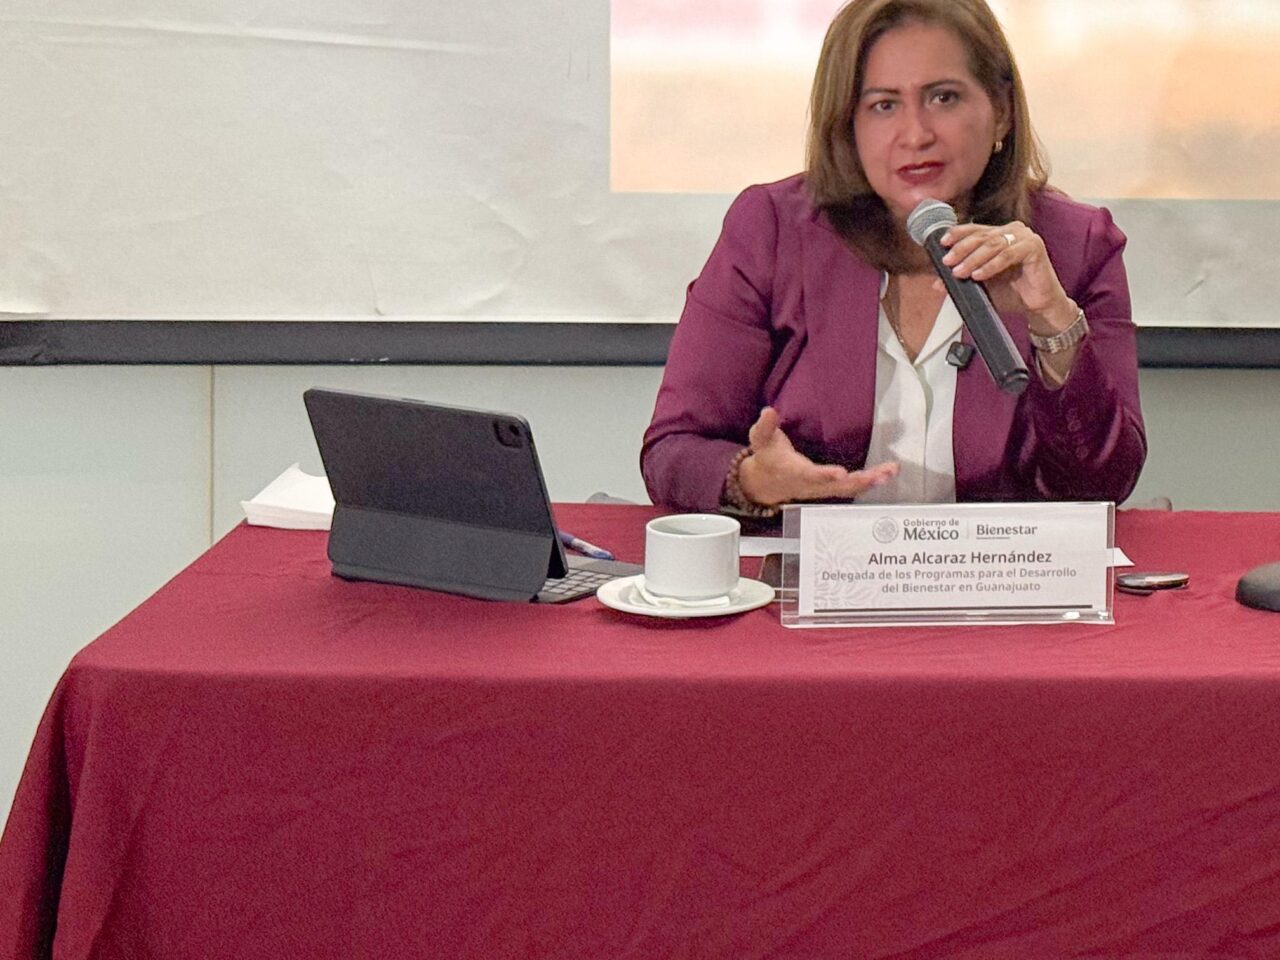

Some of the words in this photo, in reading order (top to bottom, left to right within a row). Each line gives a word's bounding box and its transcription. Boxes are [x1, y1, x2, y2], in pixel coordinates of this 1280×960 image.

[903, 518, 946, 527] Gobierno
[949, 518, 960, 527] de
[903, 526, 959, 541] México
[976, 524, 1038, 537] Bienestar
[868, 552, 907, 566] Alma
[911, 551, 966, 565] Alcaraz
[970, 550, 1052, 564] Hernández
[822, 570, 874, 582] Delegada
[878, 569, 892, 579] de
[896, 569, 911, 579] los
[914, 569, 975, 582] Programas
[978, 570, 1003, 581] para
[1006, 568, 1016, 578] el
[1019, 566, 1077, 578] Desarrollo
[882, 583, 899, 593] del
[902, 582, 955, 593] Bienestar
[959, 584, 972, 592] en
[975, 581, 1041, 594] Guanajuato
